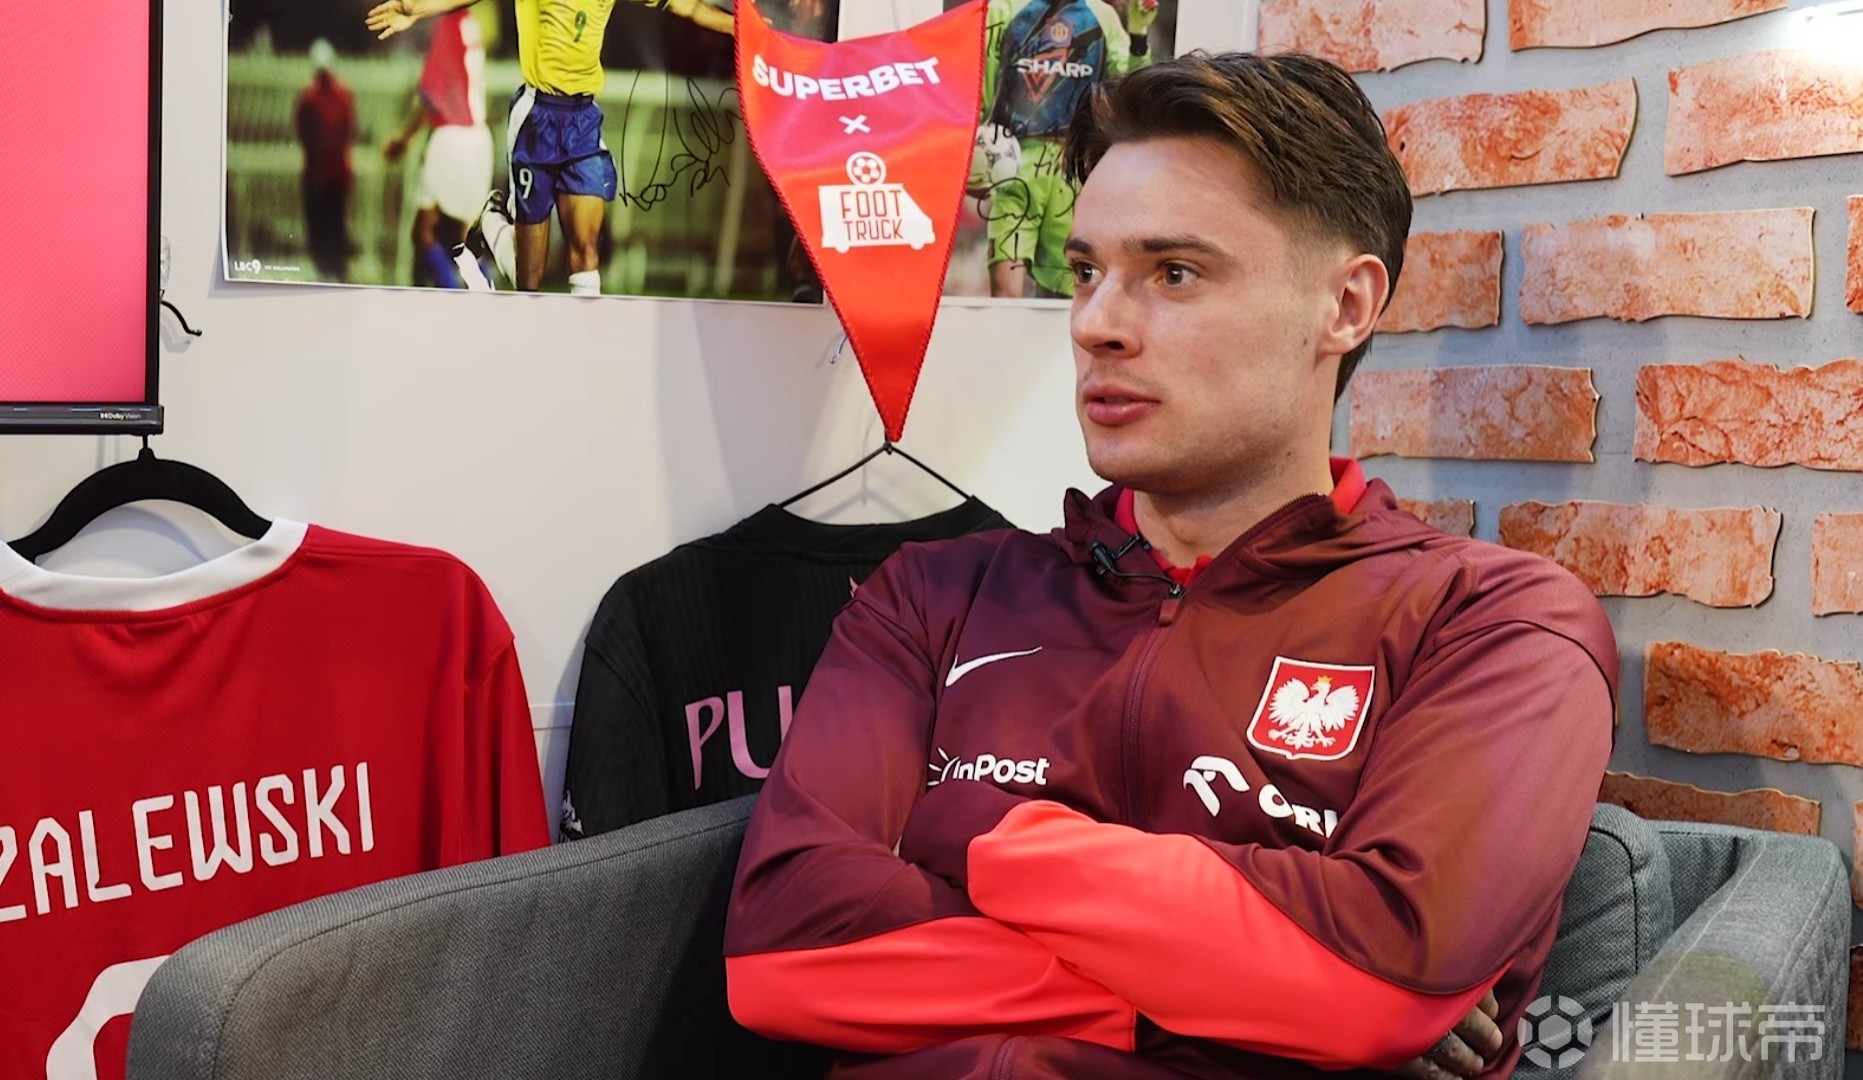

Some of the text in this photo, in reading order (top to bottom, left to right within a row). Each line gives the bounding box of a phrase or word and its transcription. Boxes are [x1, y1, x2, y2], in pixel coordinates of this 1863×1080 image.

[573, 10, 587, 43] 9
[752, 54, 941, 101] SUPERBET
[1016, 57, 1094, 78] SHARP
[519, 167, 534, 200] 9
[840, 190, 902, 219] FOOT
[843, 218, 904, 241] TRUCK
[0, 761, 375, 923] ZALEWSKI
